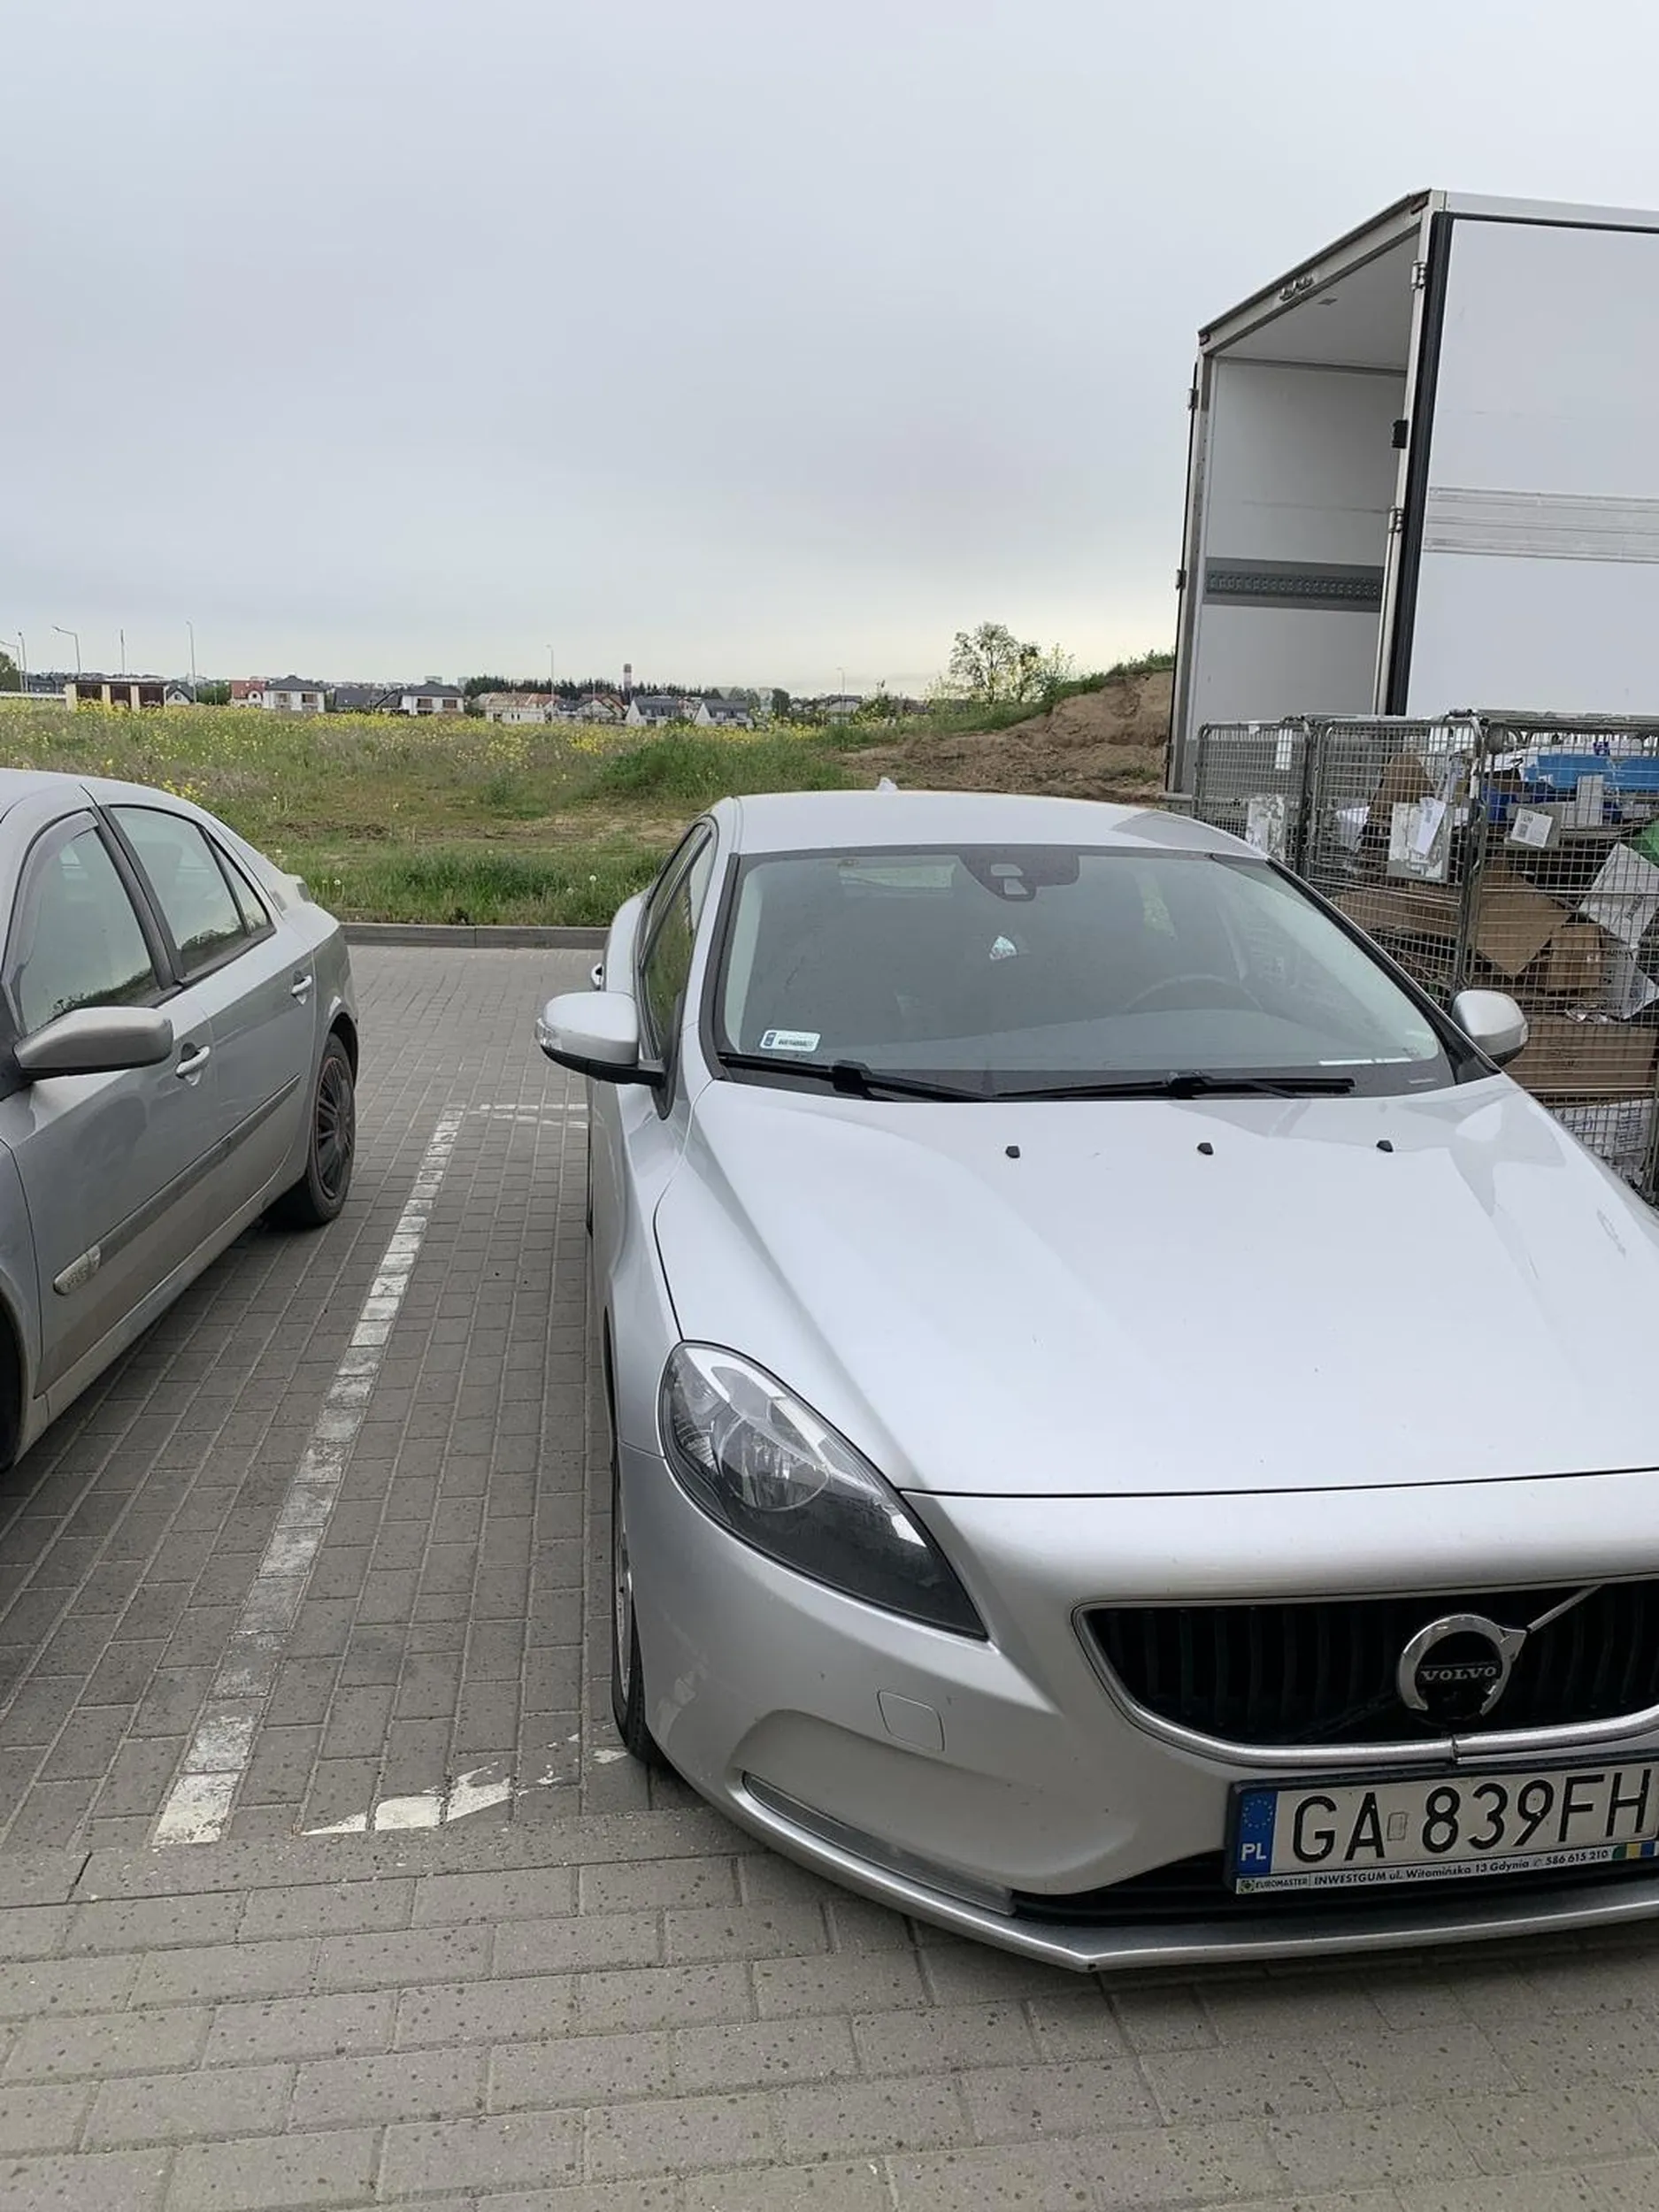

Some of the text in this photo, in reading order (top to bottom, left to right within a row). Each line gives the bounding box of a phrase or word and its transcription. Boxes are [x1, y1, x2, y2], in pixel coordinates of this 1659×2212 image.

[1421, 1666, 1497, 1681] VOLVO
[1292, 1769, 1652, 1863] GA 839FH
[1241, 1842, 1267, 1861] PL
[1255, 1878, 1307, 1890] EUROMASTER
[1314, 1871, 1387, 1886] INWESTGUM
[1406, 1864, 1471, 1878] Witomińska
[1475, 1863, 1488, 1873] 13
[1489, 1860, 1530, 1873] Gdynia
[1546, 1855, 1566, 1866] 586
[1568, 1853, 1586, 1863] 615
[1589, 1849, 1609, 1861] 210
